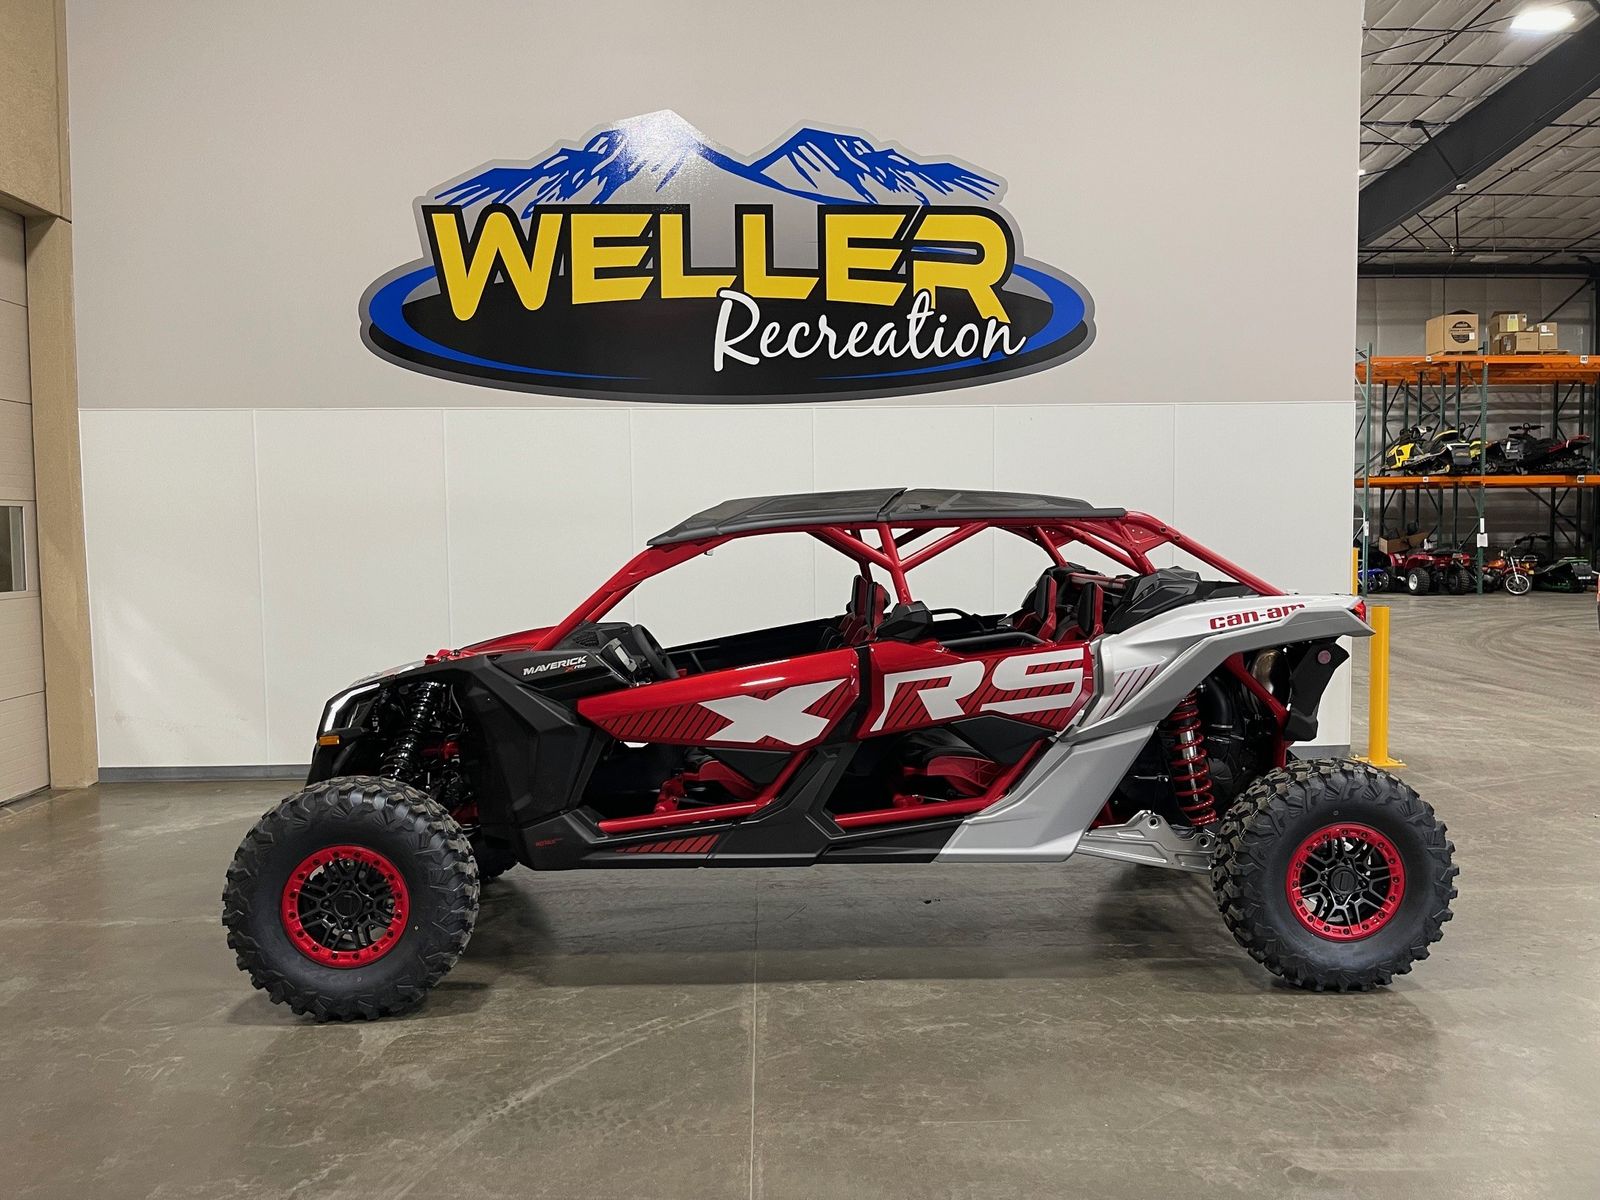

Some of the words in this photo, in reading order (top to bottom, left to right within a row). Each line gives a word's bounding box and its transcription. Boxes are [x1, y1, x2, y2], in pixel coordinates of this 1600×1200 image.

[431, 213, 1010, 323] WELLER
[713, 289, 1027, 372] Recreation
[523, 655, 587, 675] MAVERICK
